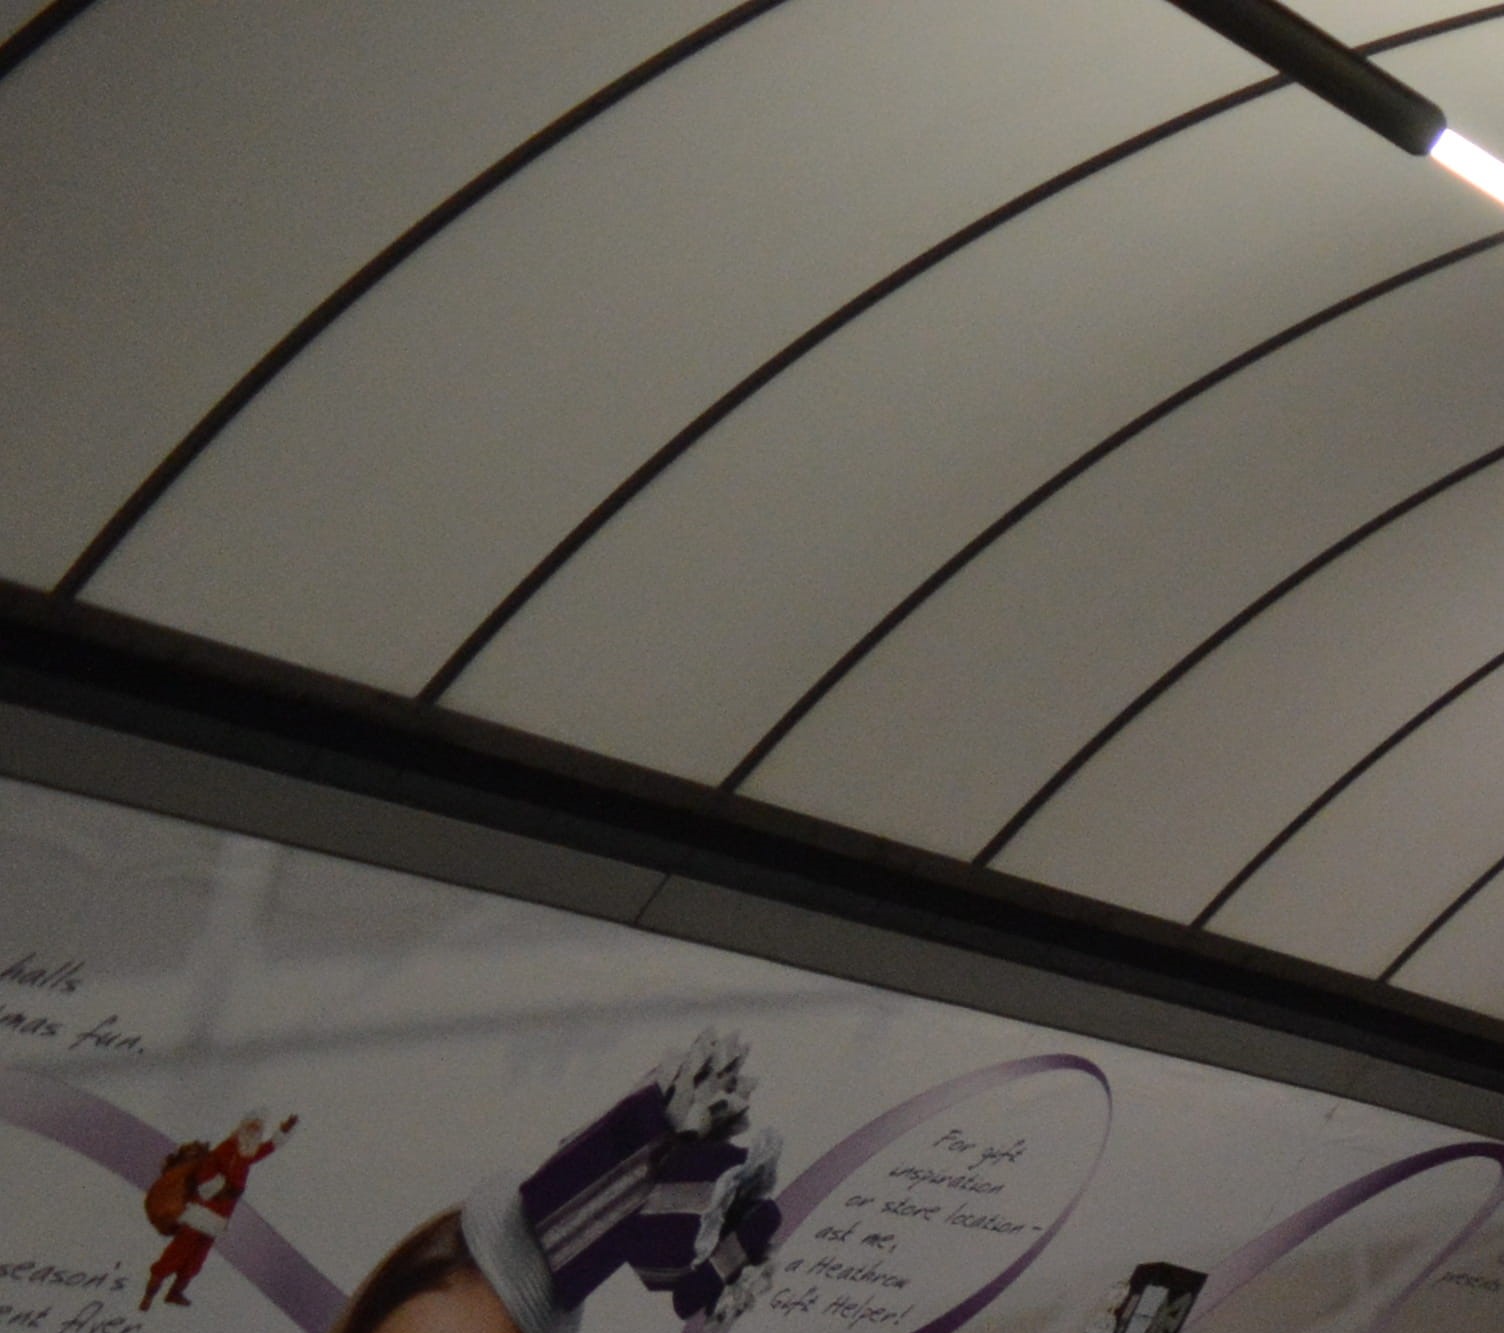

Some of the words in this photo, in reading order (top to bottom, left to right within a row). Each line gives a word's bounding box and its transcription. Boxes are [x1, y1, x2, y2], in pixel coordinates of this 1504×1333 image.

[0, 950, 86, 994] halls
[0, 1003, 61, 1037] mas
[68, 1013, 146, 1055] fun.
[932, 1127, 976, 1154] For
[966, 1137, 1027, 1171] gift
[889, 1165, 1006, 1195] inspiration
[844, 1194, 876, 1208] or
[880, 1196, 942, 1222] store
[943, 1201, 1027, 1235] location
[813, 1220, 862, 1243] ask
[861, 1232, 898, 1254] me,
[0, 1259, 128, 1292] season's
[784, 1257, 805, 1273] a
[806, 1255, 911, 1290] Heathrow
[768, 1284, 820, 1317] Gift
[822, 1294, 916, 1330] Helper!
